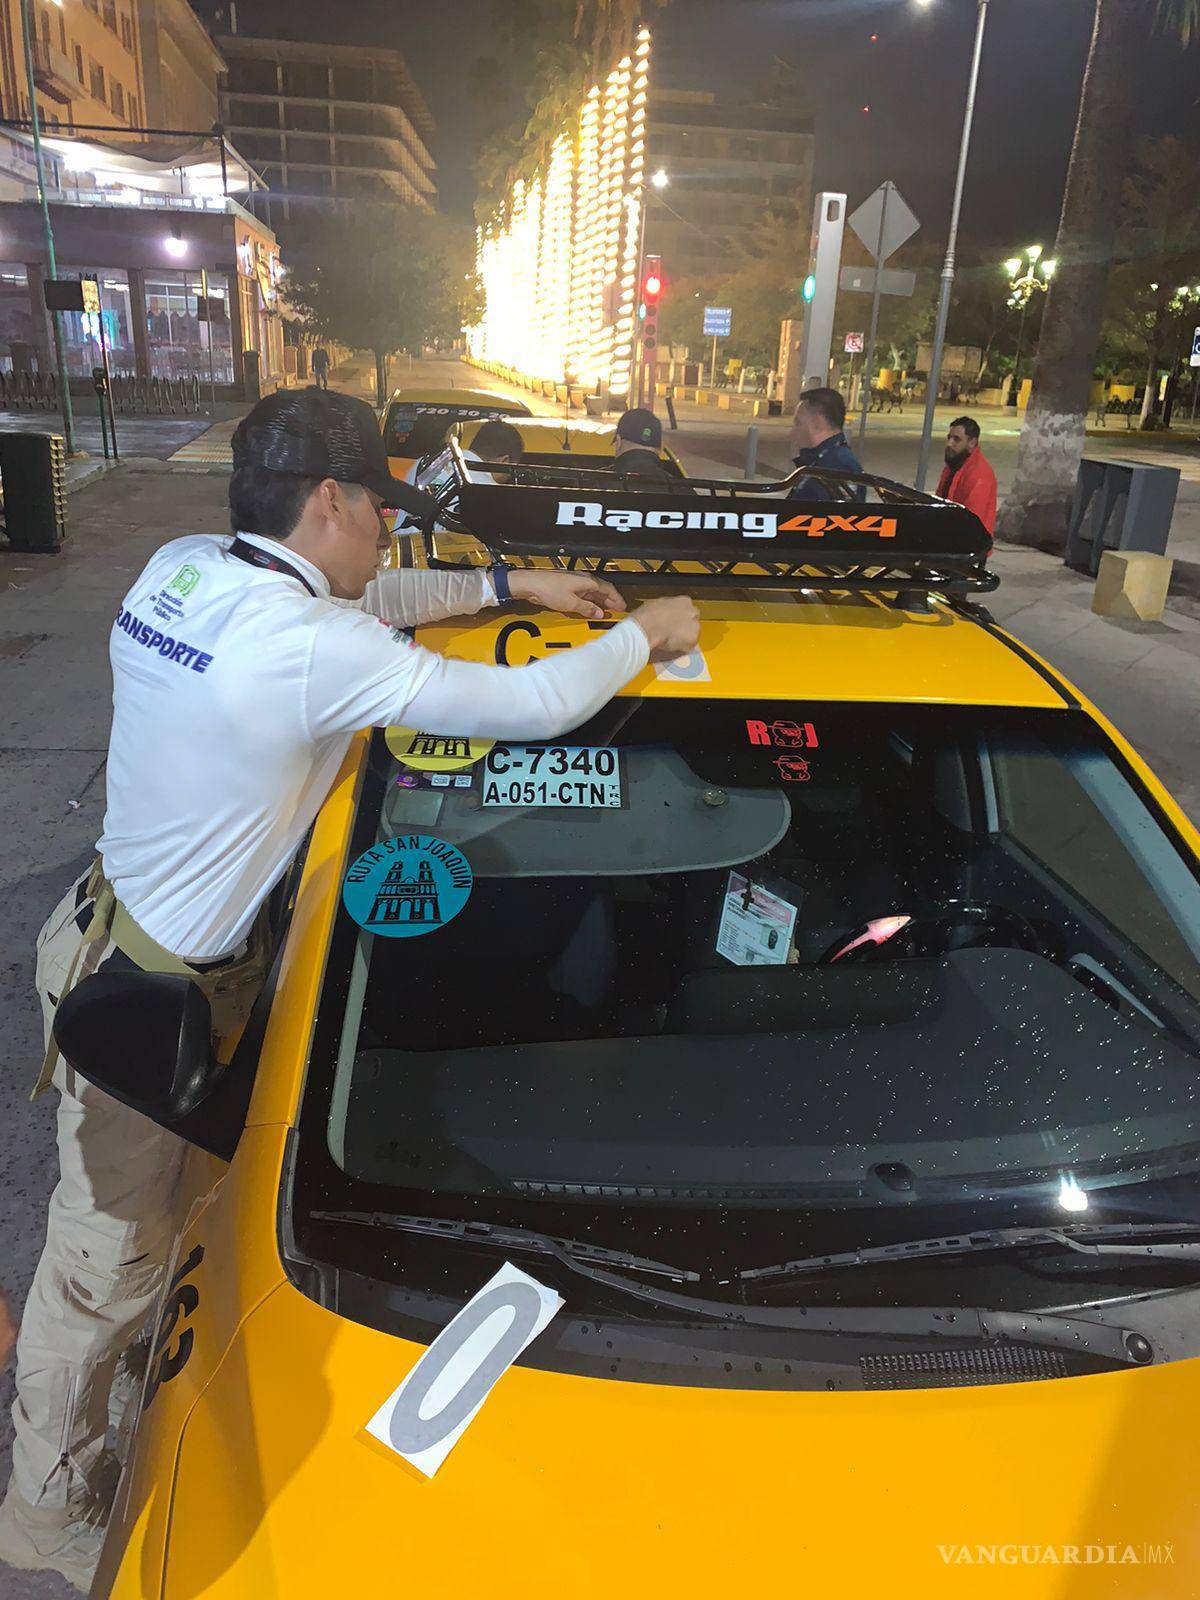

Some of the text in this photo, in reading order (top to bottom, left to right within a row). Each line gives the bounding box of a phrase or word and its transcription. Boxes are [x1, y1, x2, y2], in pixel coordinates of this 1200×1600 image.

[555, 501, 898, 538] Racing 4x4
[486, 747, 615, 776] C-7340
[485, 781, 605, 804] A-051-CTN
[347, 836, 472, 888] RUTA SAN JOAQUIN
